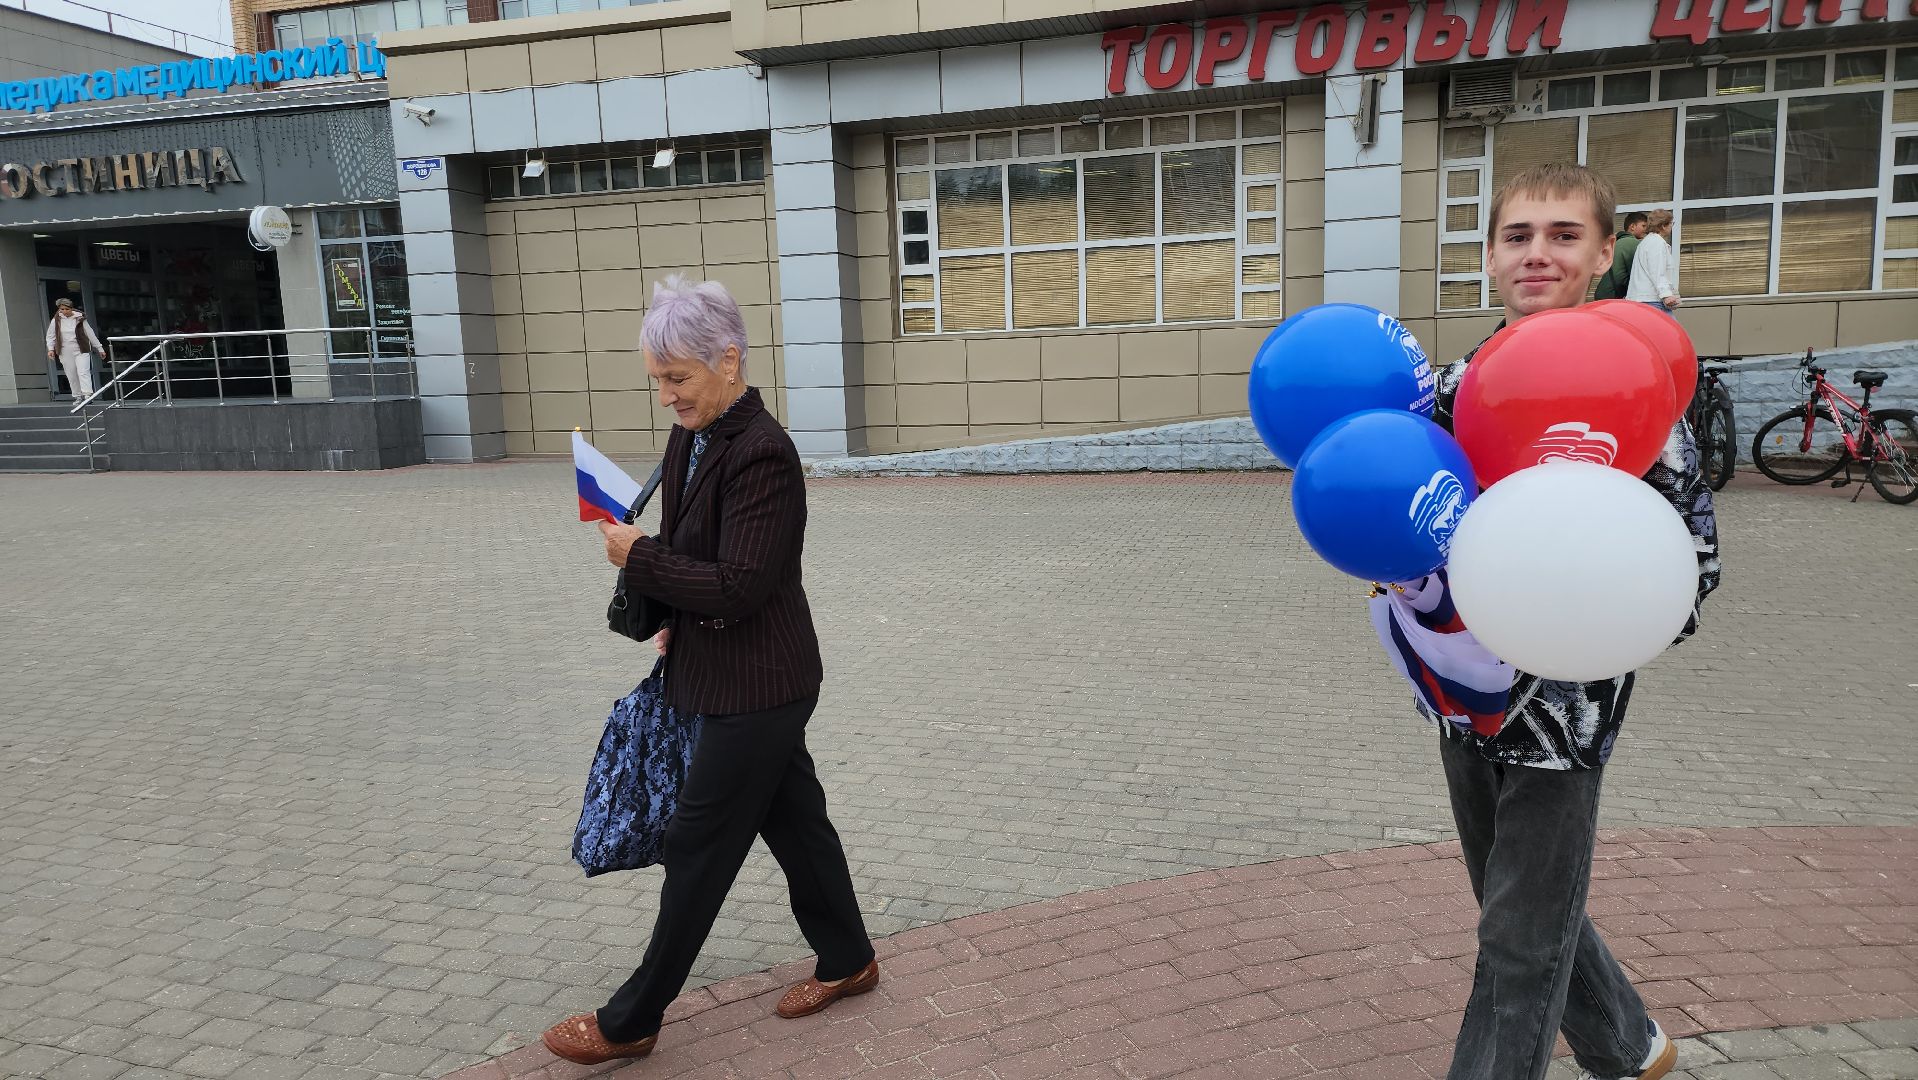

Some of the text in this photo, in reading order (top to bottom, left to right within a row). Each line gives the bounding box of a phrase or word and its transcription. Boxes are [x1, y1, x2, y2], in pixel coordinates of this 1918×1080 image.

[115, 37, 349, 99] МЕДИЦИНСКИЙ
[357, 39, 387, 78] Ц
[1101, 0, 1563, 94] ТОРГОВЫЙ
[100, 248, 140, 263] ЦВЕТЫ
[335, 263, 363, 307] ЛОМБАРД
